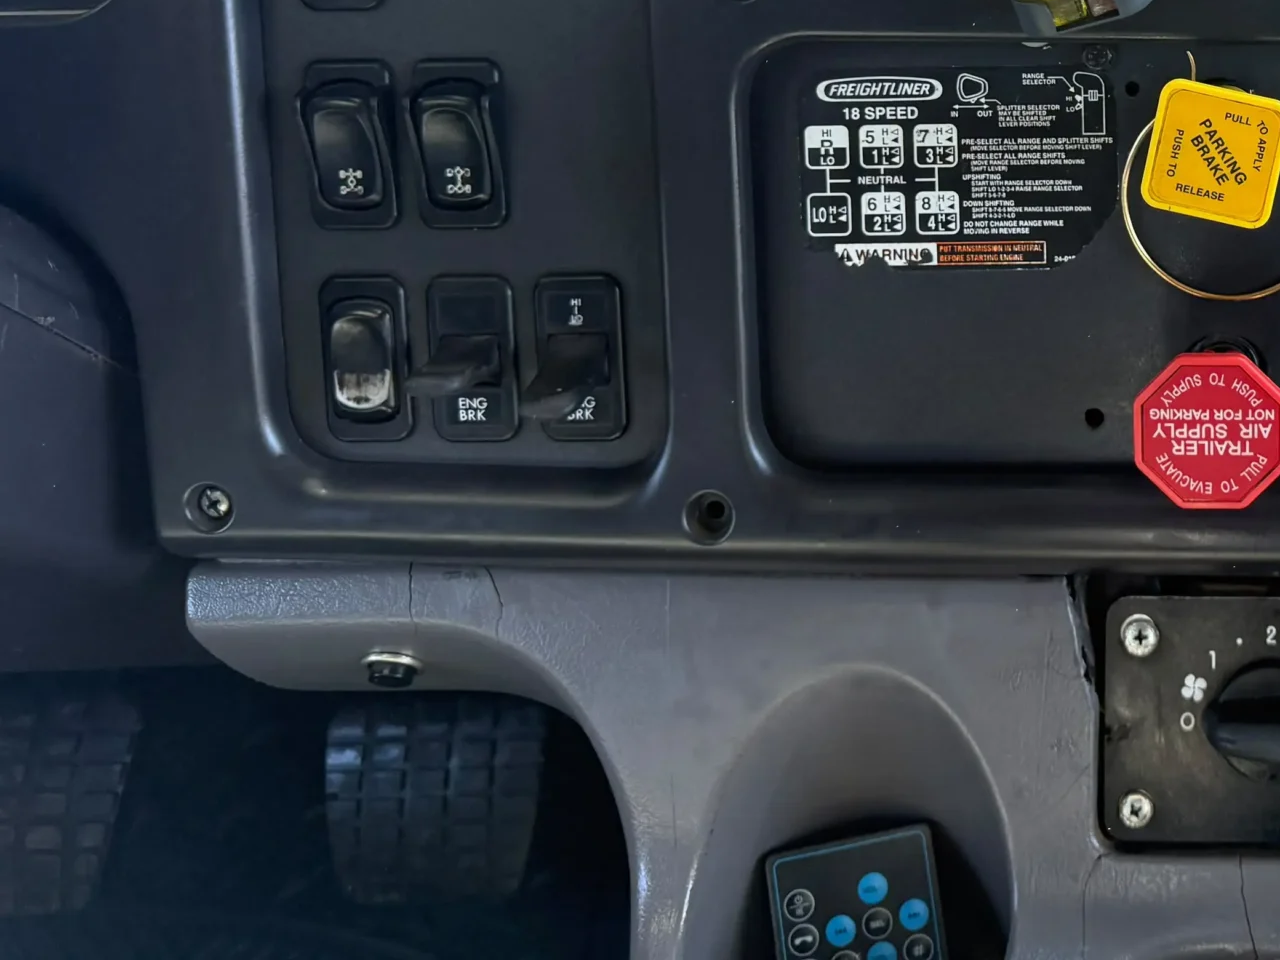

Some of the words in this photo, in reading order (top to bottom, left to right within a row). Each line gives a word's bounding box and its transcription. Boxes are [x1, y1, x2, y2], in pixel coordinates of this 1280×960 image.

[829, 82, 931, 97] FREIGHTLINER
[842, 107, 860, 120] 18
[864, 106, 919, 120] SPEED
[1224, 112, 1251, 126] PULL
[821, 129, 832, 138] HI
[919, 129, 929, 143] 7
[935, 127, 943, 135] H
[1257, 120, 1269, 135] TO
[865, 130, 875, 144] 5
[881, 128, 889, 136] H
[882, 137, 889, 145] L
[936, 136, 943, 144] L
[1090, 136, 1113, 144] SHIFTS
[1170, 128, 1184, 159] PUSH
[820, 139, 834, 155] R
[925, 149, 934, 163] 3
[936, 146, 944, 155] H
[1199, 118, 1247, 185] PARKING
[820, 157, 835, 166] LO
[872, 149, 878, 164] 1
[882, 147, 890, 155] H
[882, 156, 889, 165] L
[937, 156, 943, 164] L
[1190, 134, 1229, 186] BRAKE
[1252, 138, 1267, 172] APPLY
[1166, 163, 1177, 177] TO
[857, 175, 907, 185] NEUTRAL
[1175, 183, 1225, 201] RELEASE
[867, 197, 877, 211] 6
[884, 195, 891, 203] H
[921, 196, 931, 210] 8
[938, 194, 945, 202] H
[812, 207, 827, 223] LO
[829, 206, 837, 214] H
[829, 215, 836, 224] L
[927, 215, 936, 230] 4
[938, 214, 946, 222] H
[873, 216, 882, 231] 2
[884, 215, 891, 223] H
[884, 223, 891, 232] L
[938, 222, 945, 231] L
[569, 298, 582, 306] HI
[1209, 373, 1226, 386] TO
[1160, 374, 1202, 407] SUPPLY
[1231, 378, 1263, 407] PUSH
[458, 397, 488, 409] ENG
[459, 409, 487, 421] BRK
[1149, 408, 1209, 420] PARKING
[1213, 408, 1242, 420] FOR
[1246, 409, 1275, 420] NOT
[1152, 423, 1228, 439] SUPPLY
[1239, 423, 1272, 439] AIR
[1171, 440, 1254, 456] TRAILER
[1155, 452, 1213, 494] EVACUATE
[1240, 454, 1268, 482] PULL
[1220, 478, 1239, 493] TO
[1265, 625, 1277, 645] 2
[1208, 650, 1217, 670] 1
